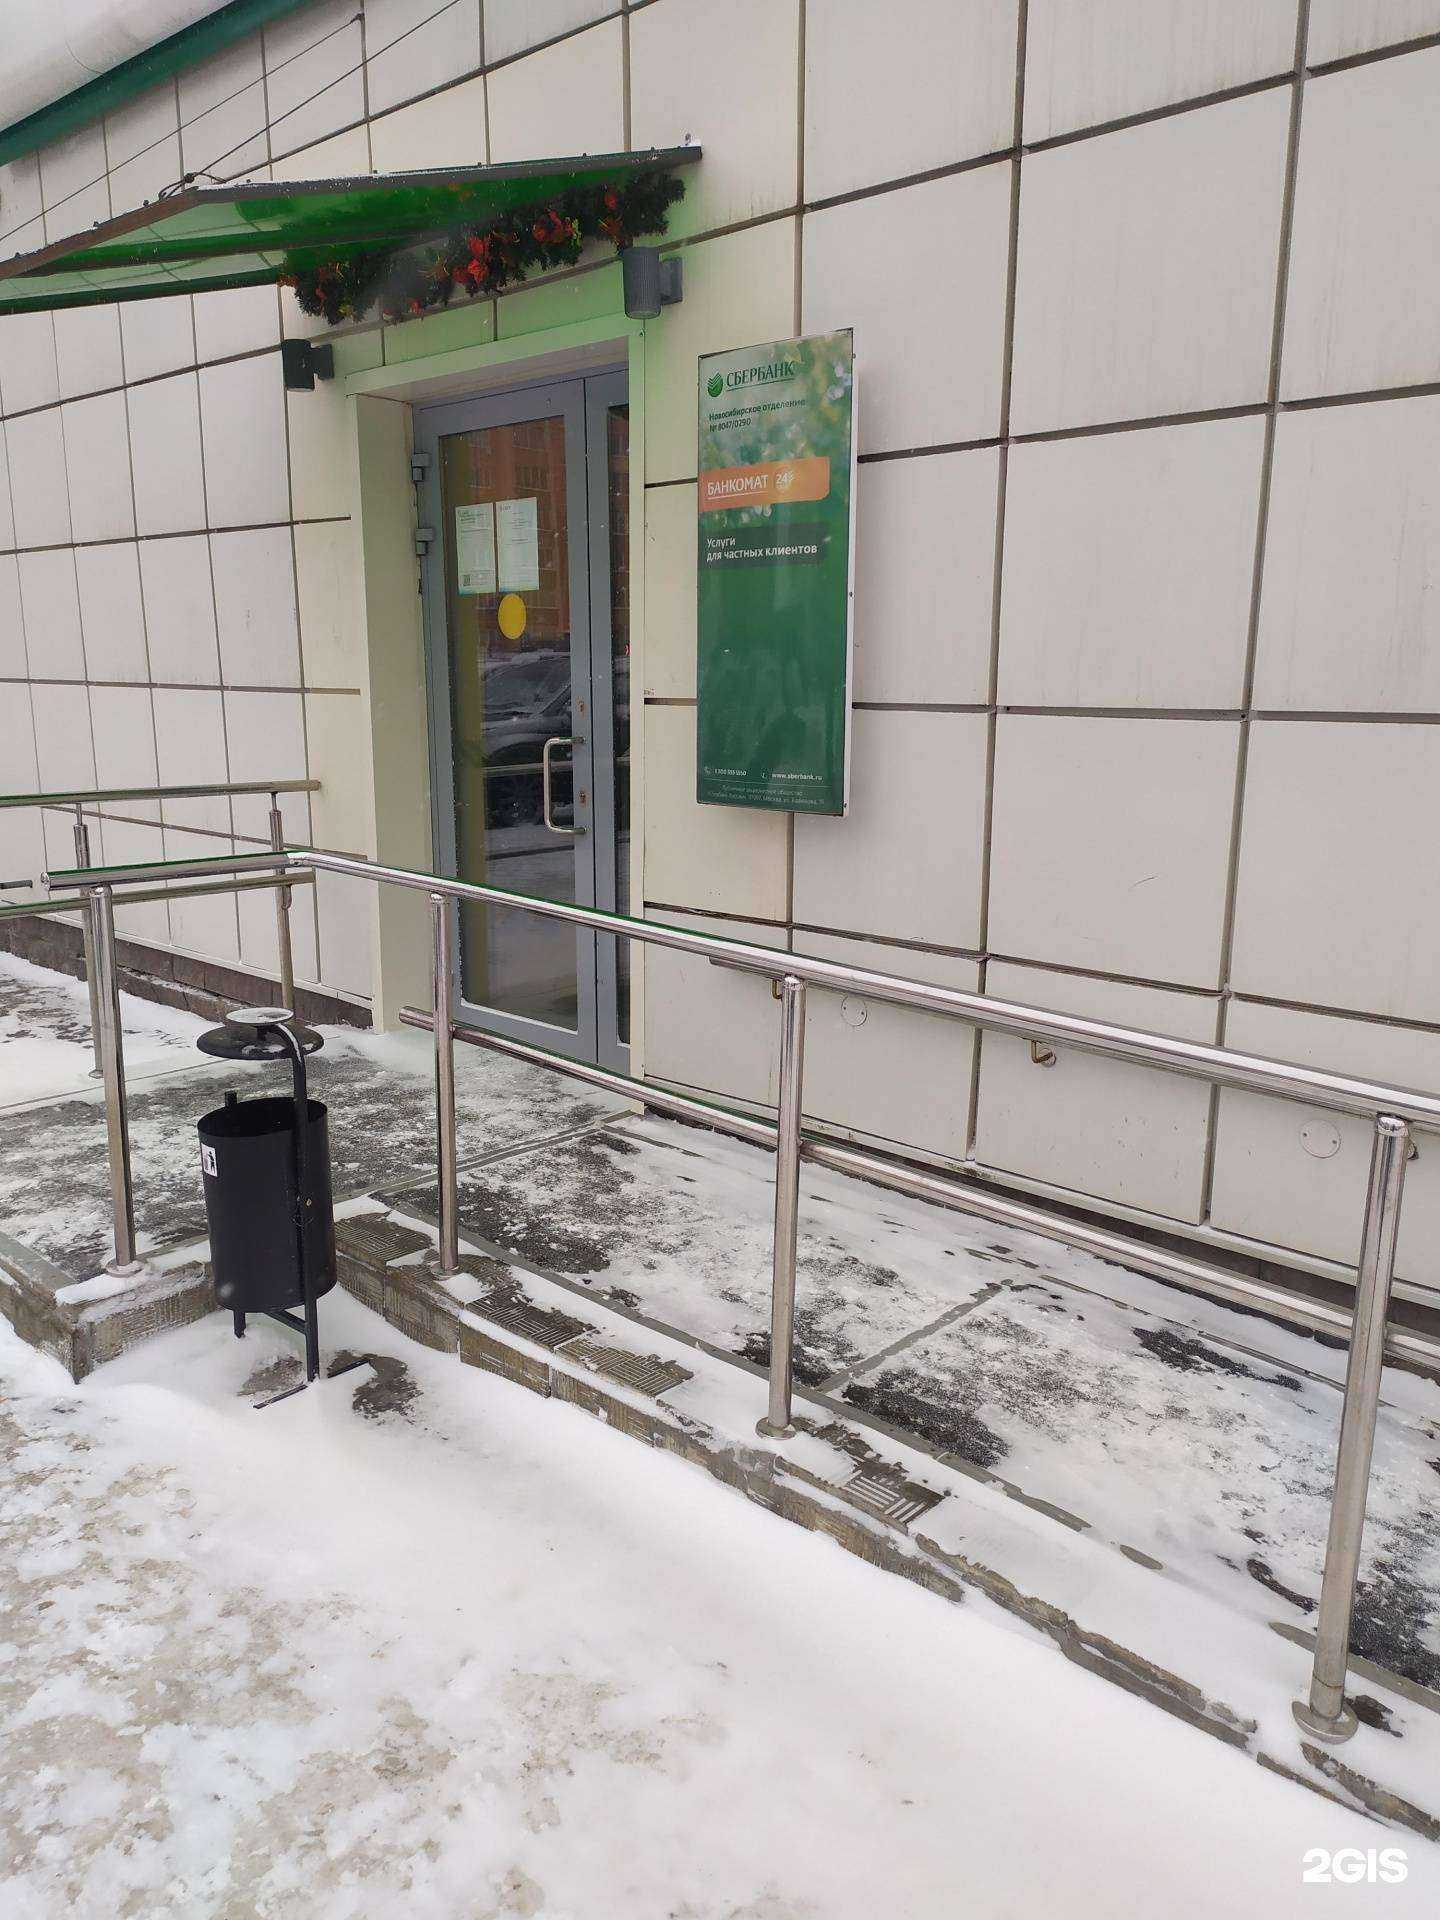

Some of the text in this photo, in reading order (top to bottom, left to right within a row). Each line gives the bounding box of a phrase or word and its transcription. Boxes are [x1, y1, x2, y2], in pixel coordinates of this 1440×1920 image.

[726, 360, 796, 388] СБЕРБАНК
[709, 400, 806, 421] Новосибирское отделение
[707, 474, 768, 496] БАНКОМАТ
[707, 537, 736, 549] Услуги
[706, 545, 818, 563] для частных клиентов
[771, 772, 822, 781] www.sberbank.ru
